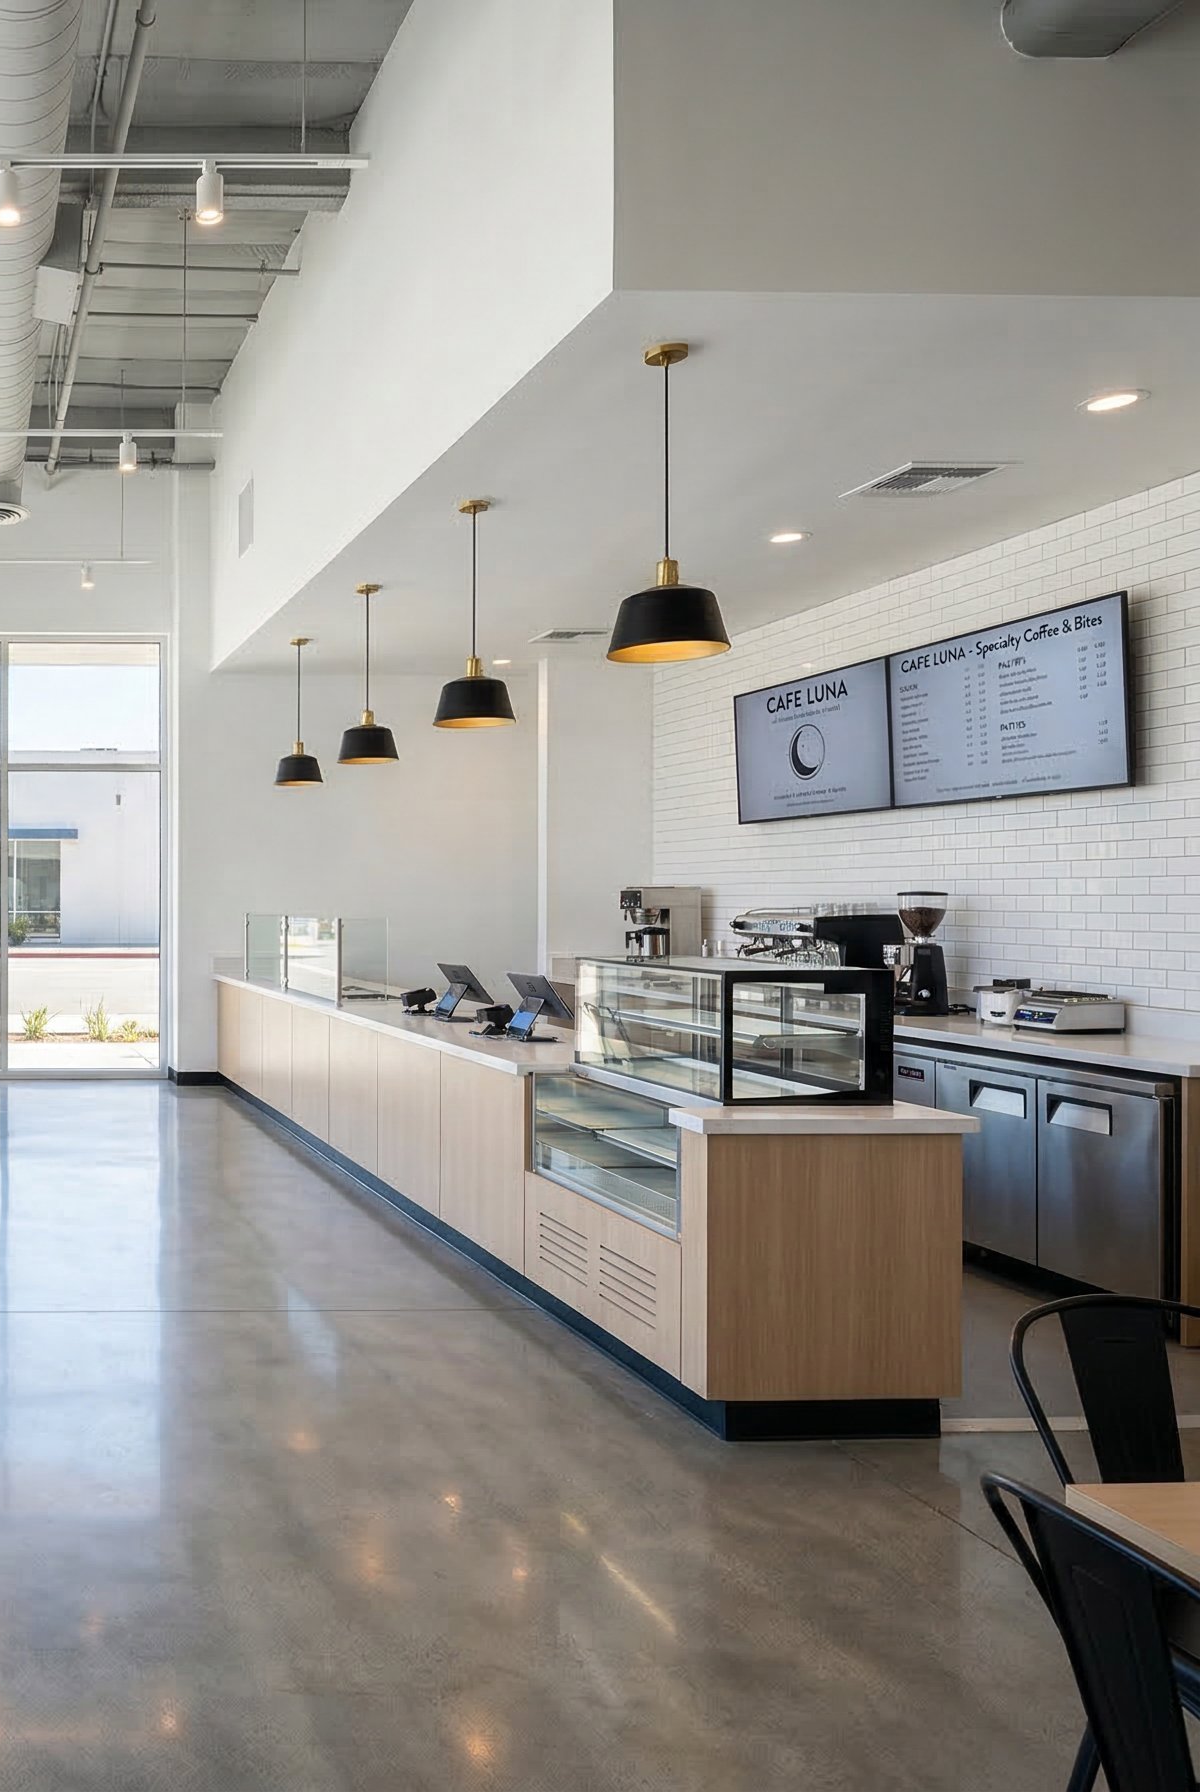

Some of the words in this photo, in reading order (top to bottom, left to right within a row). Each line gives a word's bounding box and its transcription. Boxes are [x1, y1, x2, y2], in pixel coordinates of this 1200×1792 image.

[901, 654, 931, 673] CAFE
[933, 646, 967, 666] LUNA
[976, 633, 1022, 659] Specialty
[1023, 624, 1060, 643] Coffee
[1062, 618, 1073, 634] &
[1074, 614, 1103, 631] Bites
[766, 689, 802, 714] CAFE
[807, 679, 849, 705] LUNA
